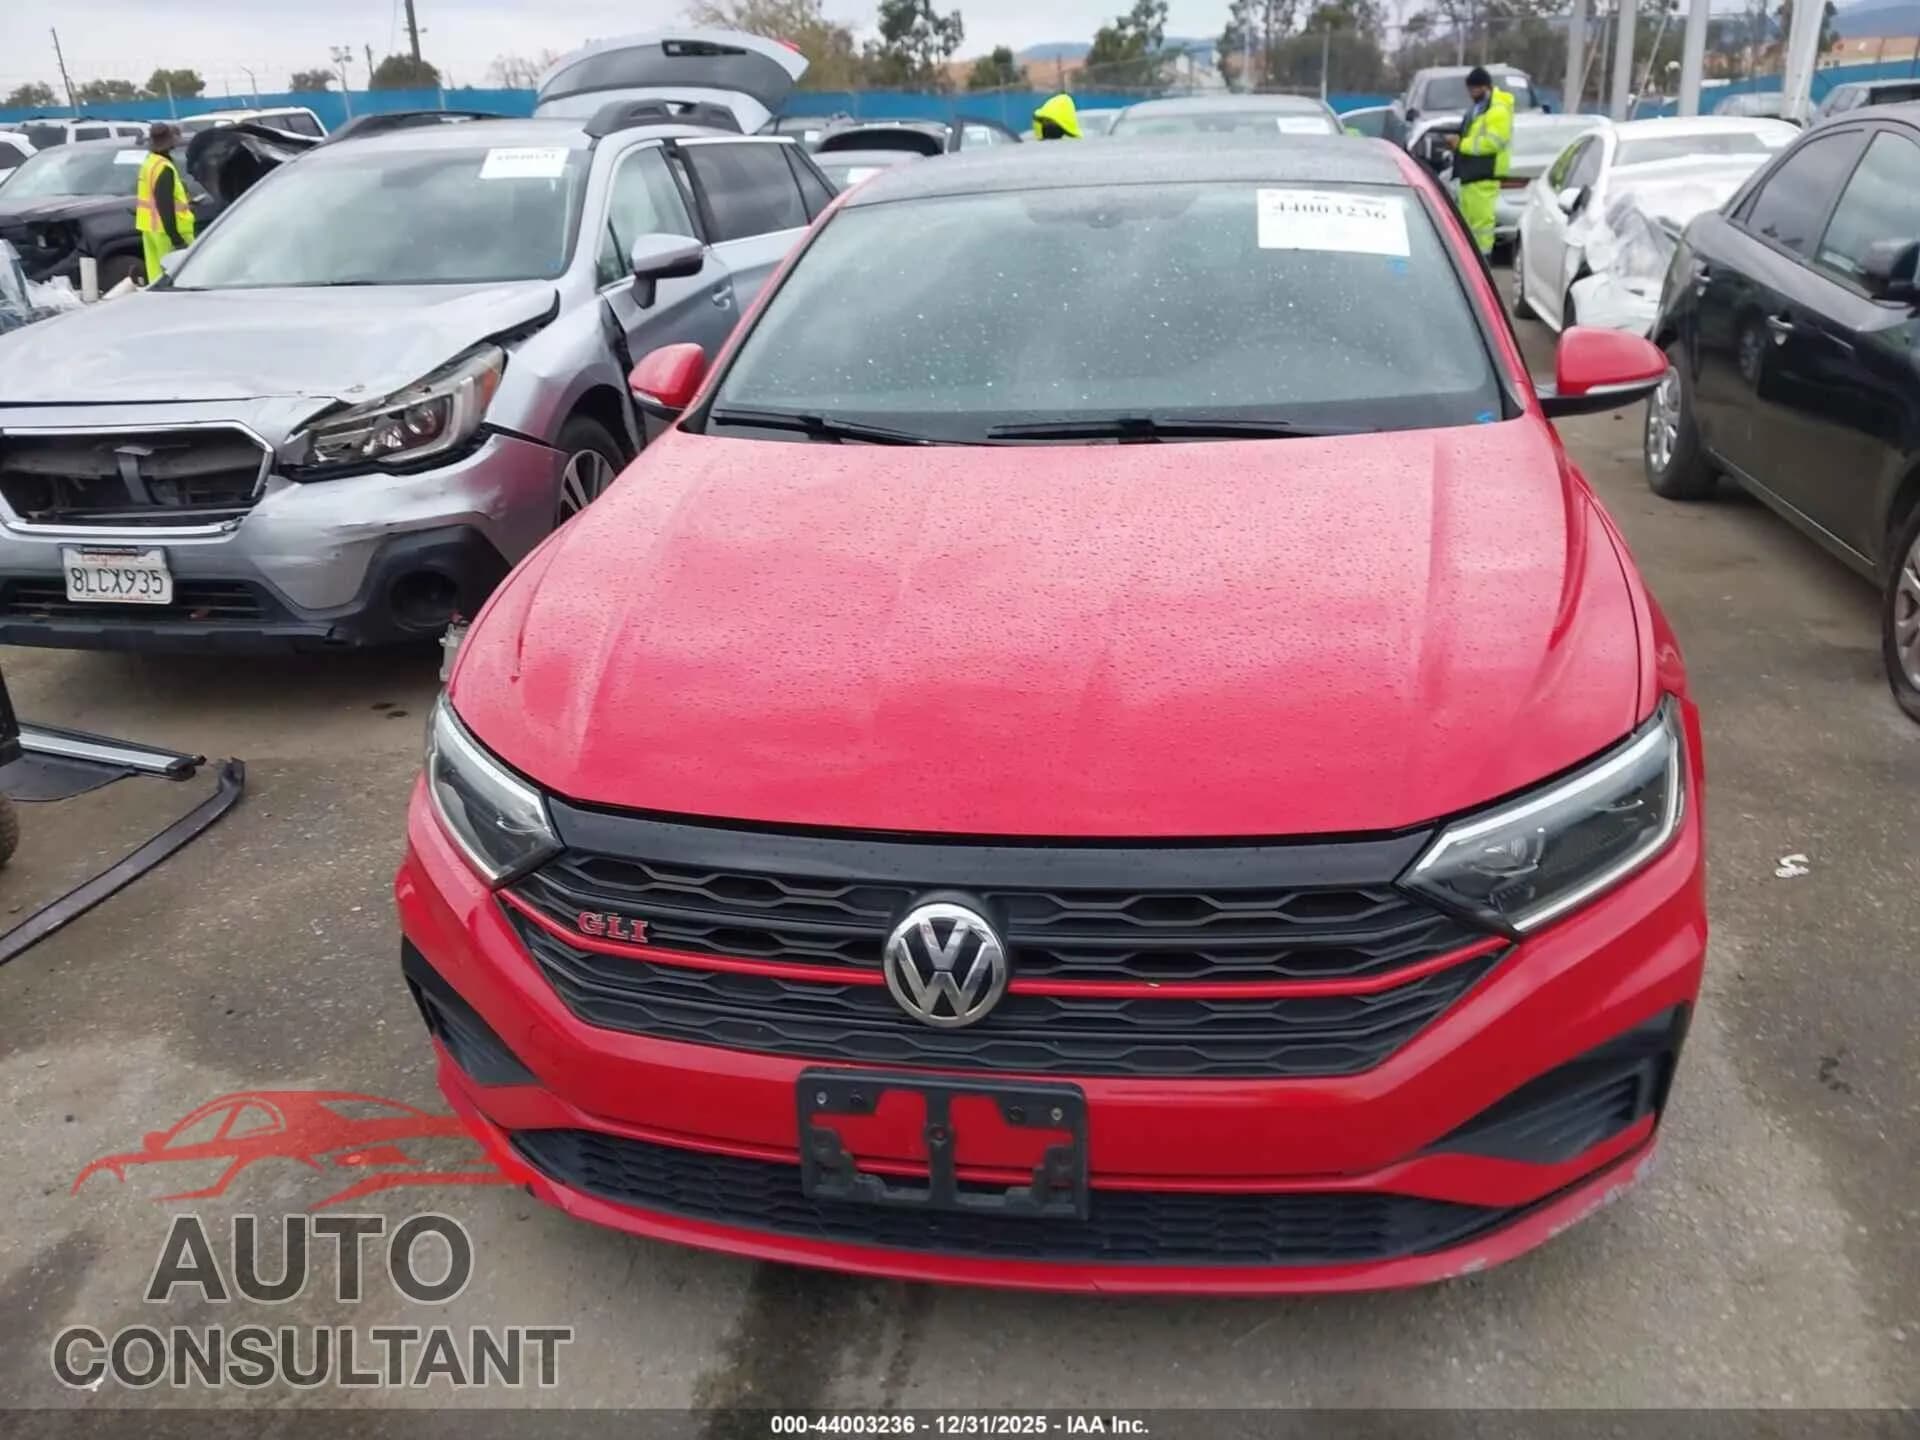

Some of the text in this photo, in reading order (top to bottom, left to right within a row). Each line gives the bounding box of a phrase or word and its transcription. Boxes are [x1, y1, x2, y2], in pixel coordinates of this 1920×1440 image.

[1272, 201, 1387, 220] 44003236
[71, 567, 163, 594] 8LCX935
[577, 911, 649, 943] GLI
